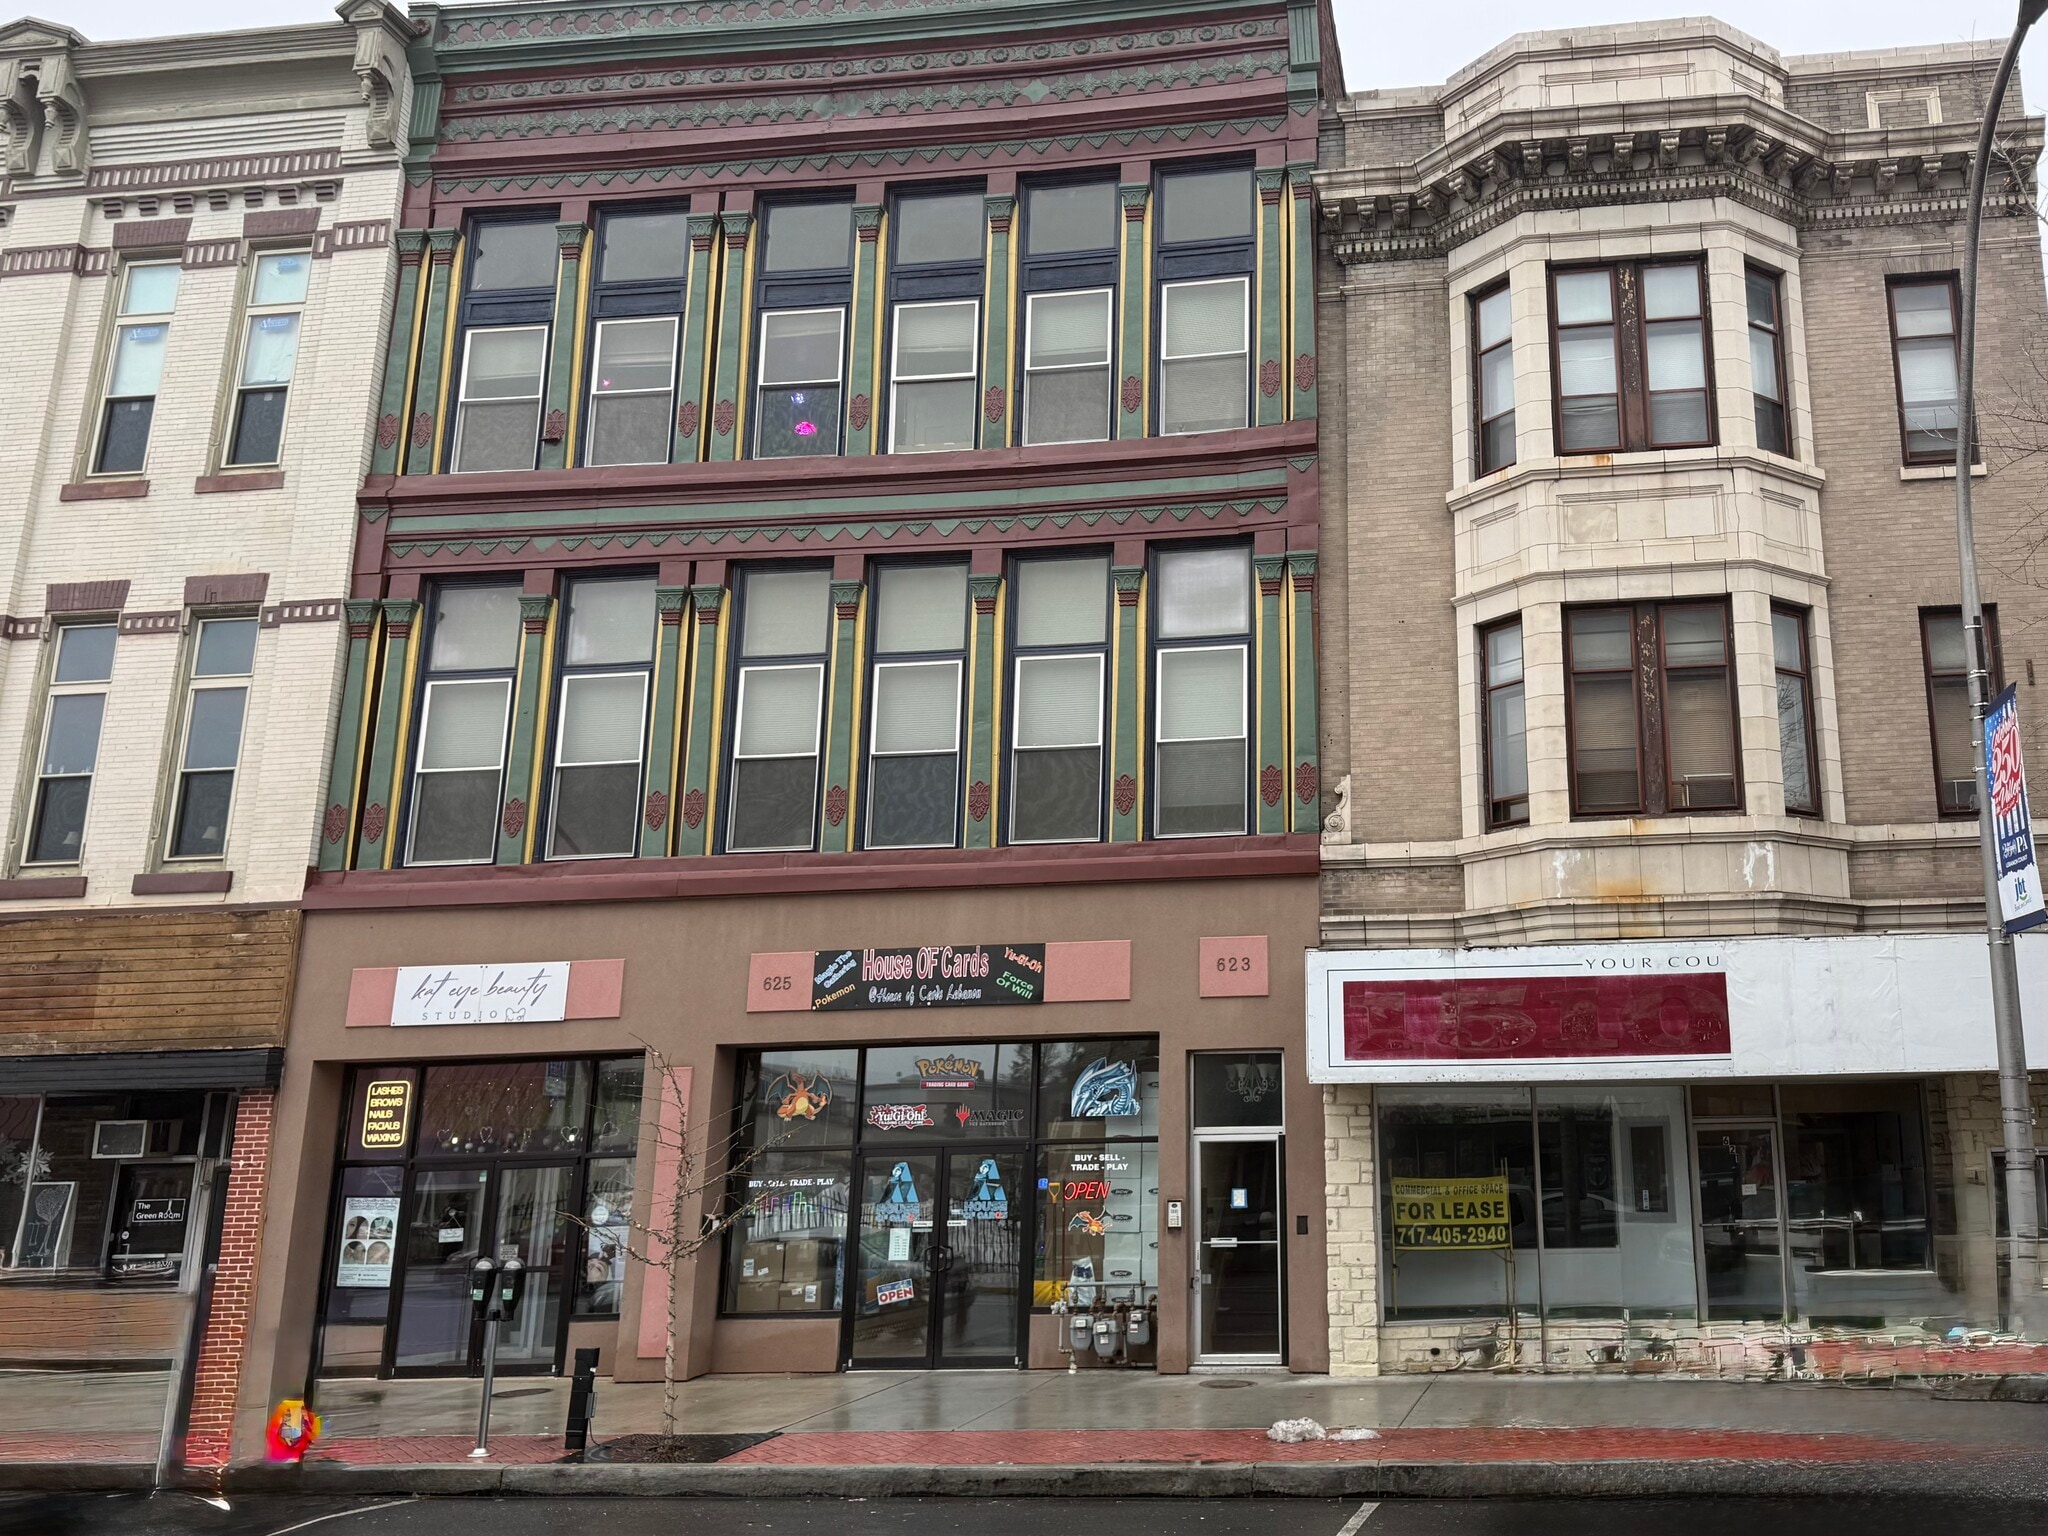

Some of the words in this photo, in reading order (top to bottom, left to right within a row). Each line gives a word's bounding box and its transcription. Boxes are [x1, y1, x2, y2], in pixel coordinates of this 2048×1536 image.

[1992, 726, 2020, 796] 250
[862, 949, 913, 982] House
[940, 945, 990, 978] Cards
[1216, 956, 1251, 972] 623
[1585, 957, 1651, 970] YOUR
[1668, 955, 1720, 968] COU
[763, 976, 792, 991] 625
[996, 977, 1012, 989] Of
[1012, 984, 1033, 999] Will
[1003, 971, 1034, 990] Force
[411, 971, 459, 1008] kat
[448, 985, 480, 1009] eye
[483, 968, 552, 1007] beauty
[814, 983, 856, 1008] Pokemon
[422, 1010, 498, 1021] STUDIO
[371, 1086, 405, 1096] LASHES
[370, 1097, 404, 1108] BROWS
[369, 1110, 394, 1119] NAILS
[970, 1109, 1025, 1121] MAGIC
[367, 1121, 401, 1131] FACIALS
[366, 1133, 401, 1143] WAXING
[1074, 1154, 1092, 1162] BUY
[1099, 1153, 1120, 1161] SELL
[1071, 1163, 1100, 1171] TRADE
[1107, 1163, 1129, 1171] PLAY
[749, 1180, 764, 1188] BUY
[1063, 1181, 1111, 1200] OPEN
[1395, 1184, 1442, 1195] COMMERCIAL
[1453, 1186, 1478, 1195] OFFICE
[1481, 1183, 1504, 1194] SPACE
[137, 1202, 151, 1210] The
[1396, 1203, 1436, 1219] FOR
[1441, 1201, 1505, 1219] LEASE
[1397, 1225, 1506, 1244] 717-405-2940
[879, 1287, 913, 1303] OPEN
